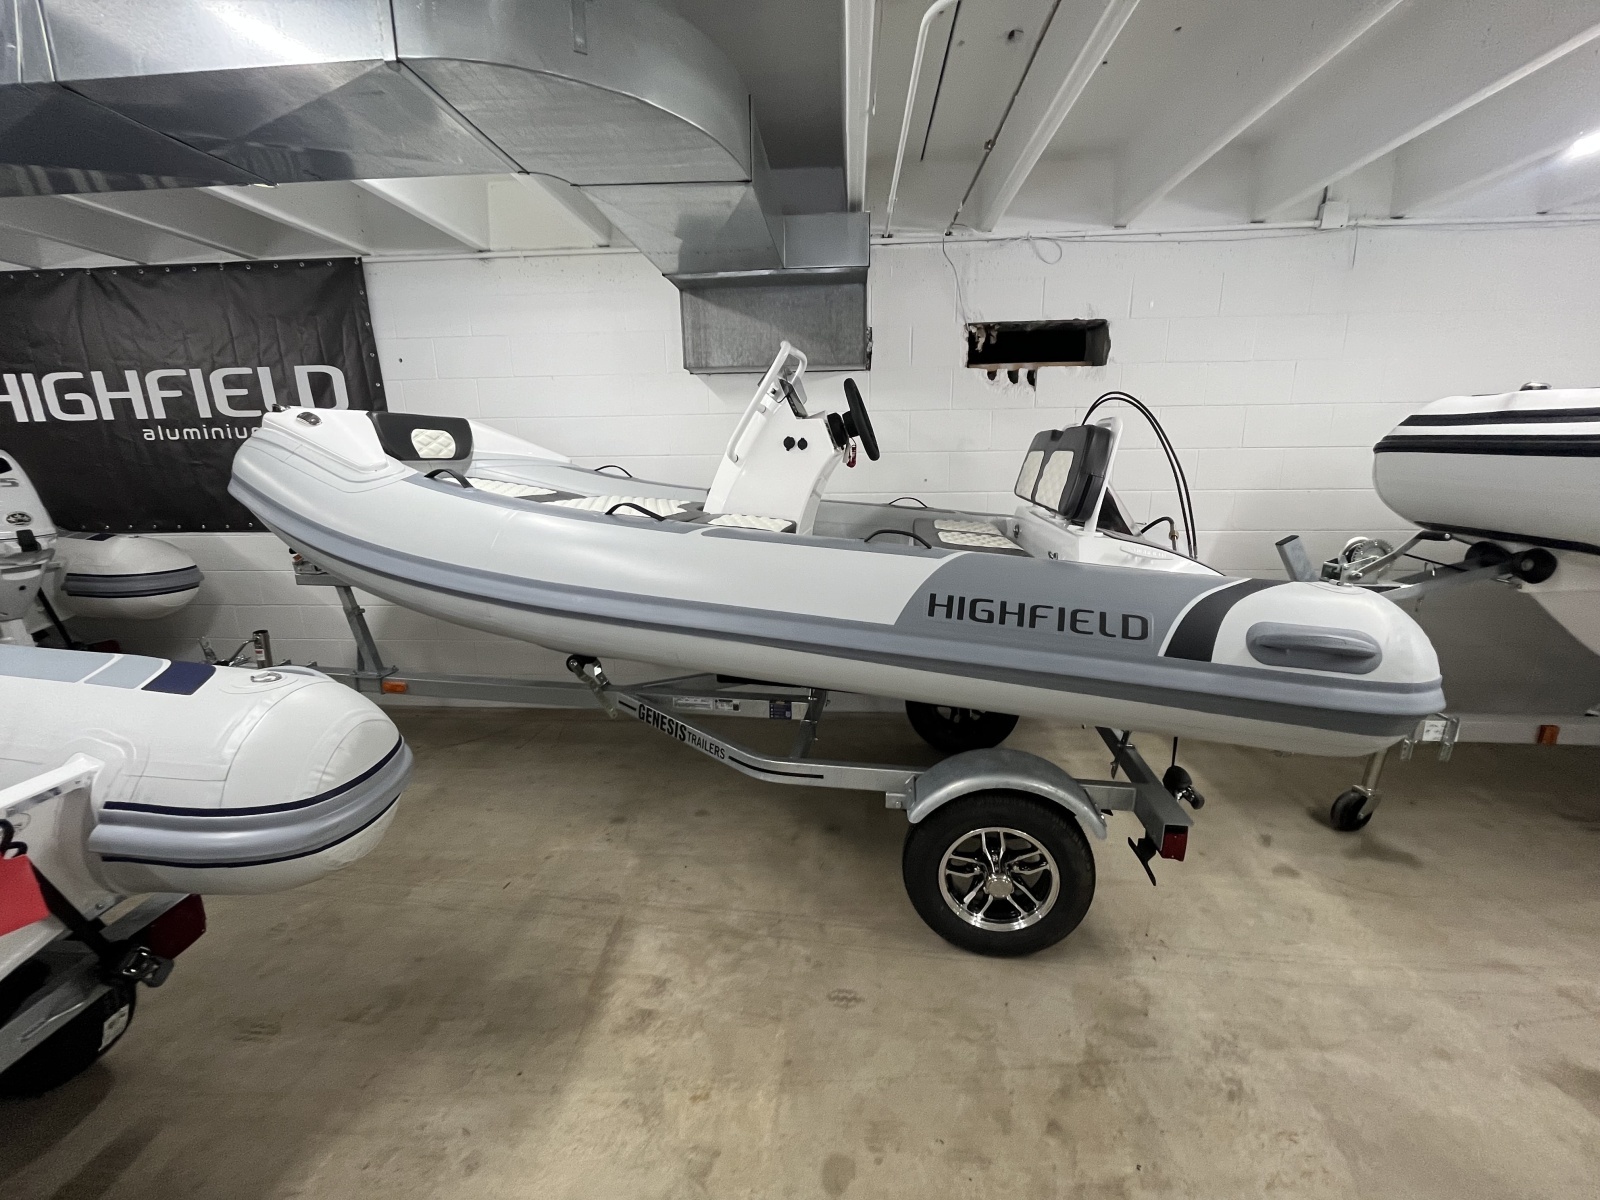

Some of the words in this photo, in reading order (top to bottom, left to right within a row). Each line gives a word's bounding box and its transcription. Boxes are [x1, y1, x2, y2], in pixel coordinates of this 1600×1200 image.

[927, 592, 1149, 641] HIGHFIELD
[638, 703, 687, 742] GENESIS
[687, 731, 726, 760] TRAILERS
